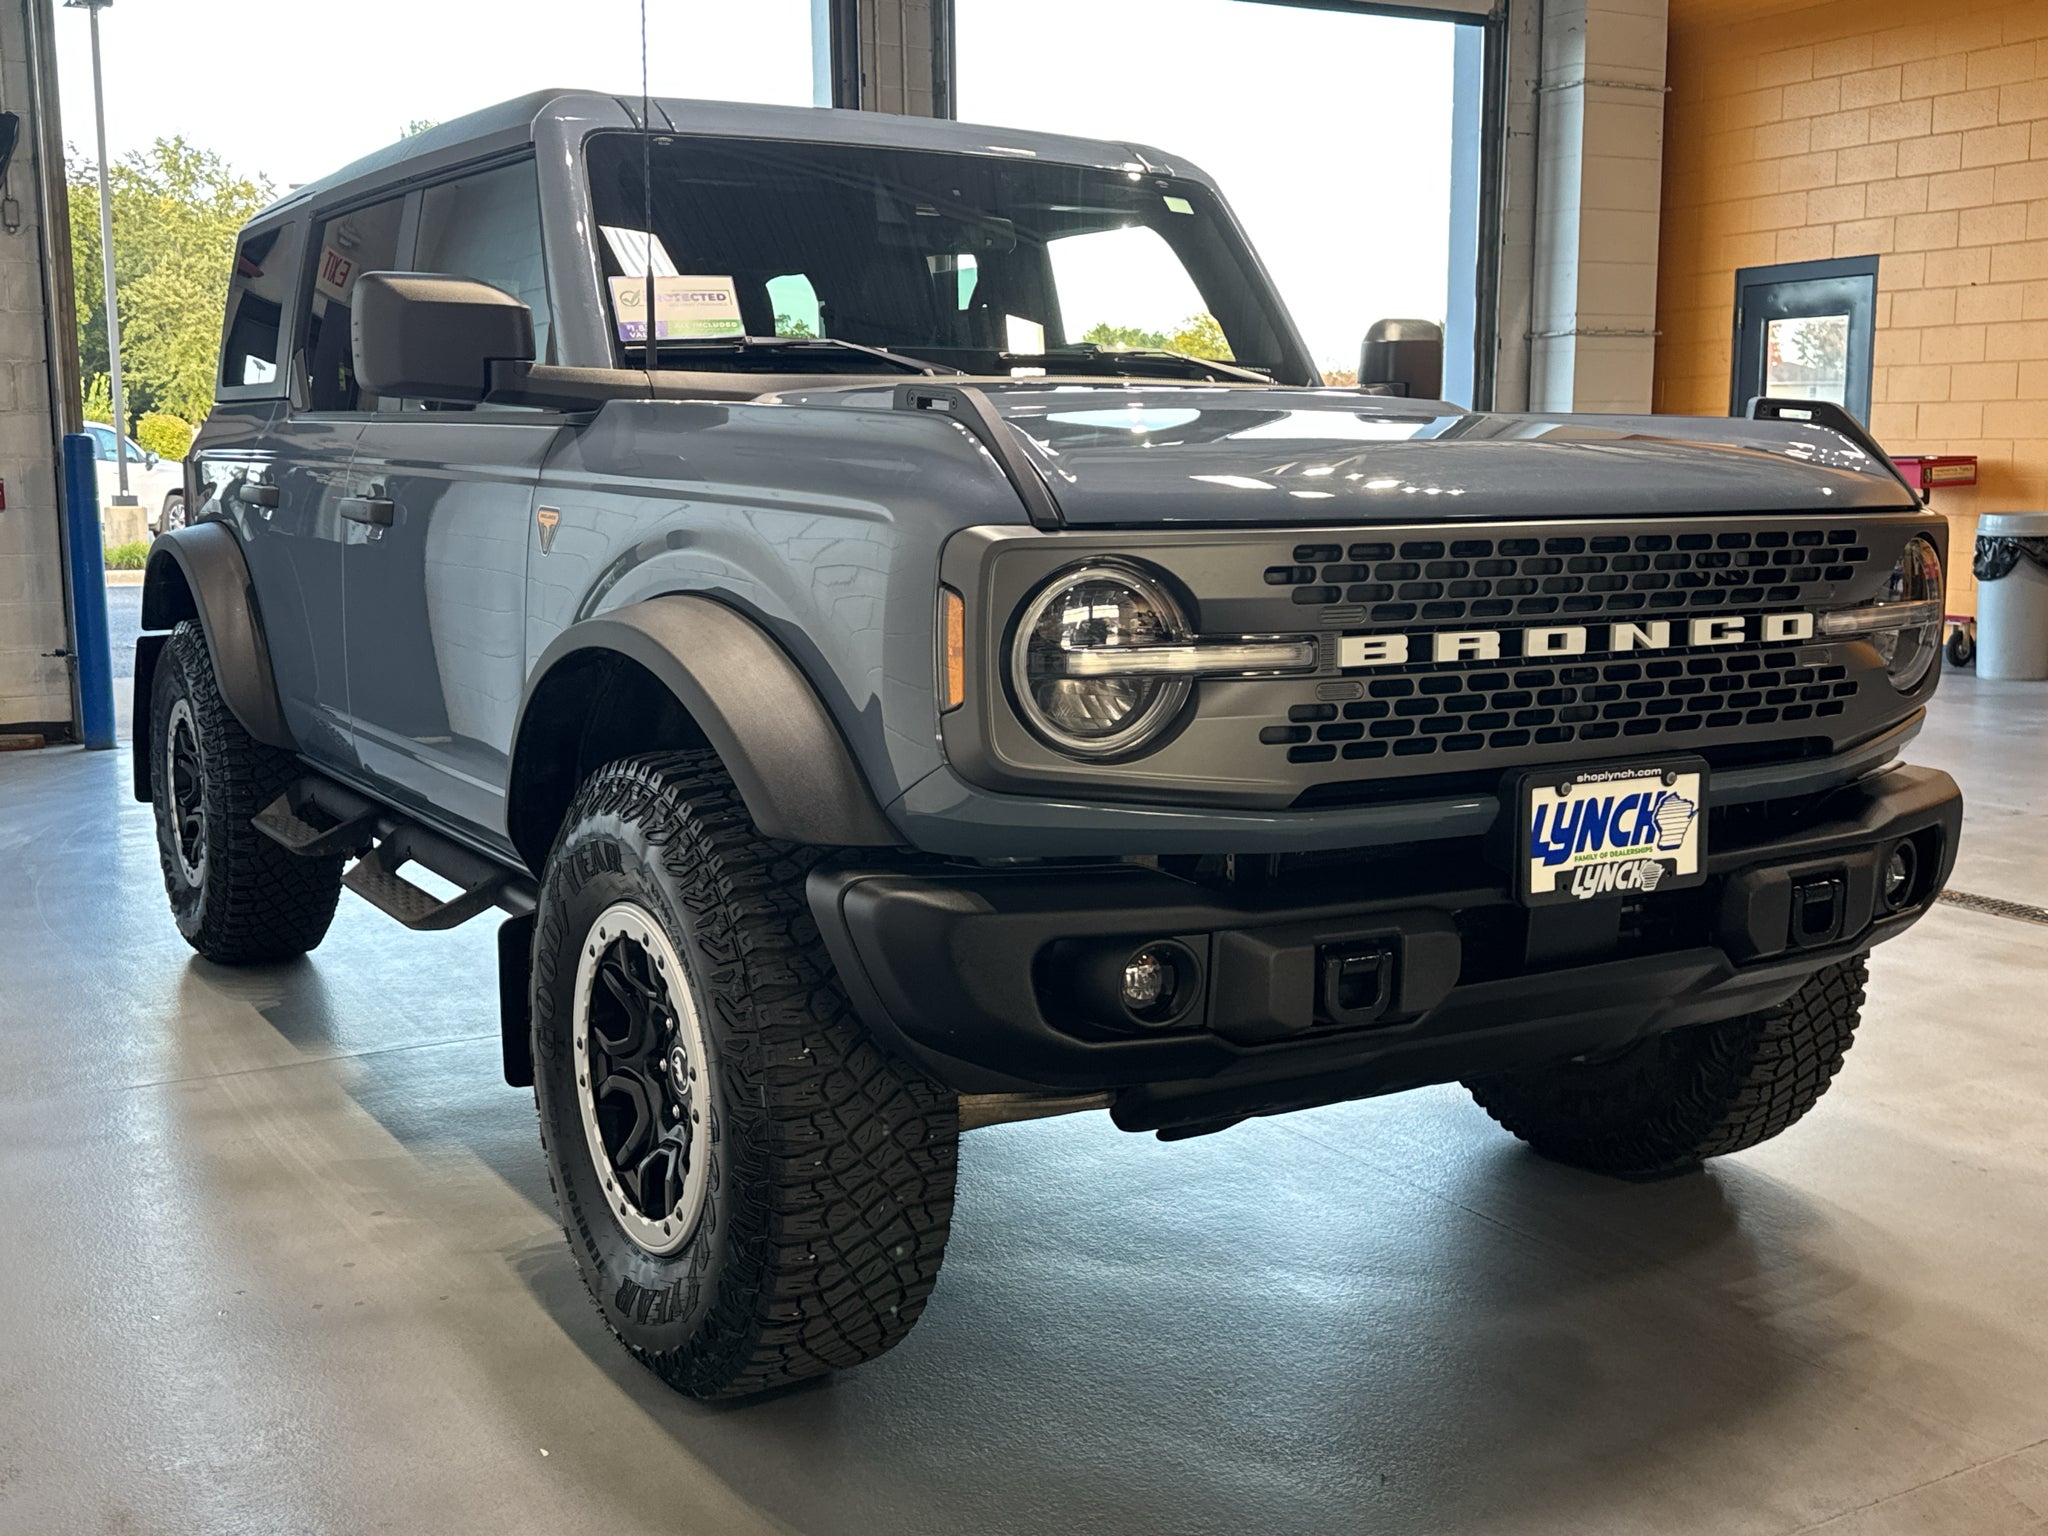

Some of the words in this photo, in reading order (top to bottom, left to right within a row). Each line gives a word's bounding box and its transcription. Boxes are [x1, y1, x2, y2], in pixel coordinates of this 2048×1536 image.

[1337, 612, 1814, 668] BRONCO
[1576, 767, 1662, 783] shoplynch.com
[1531, 790, 1667, 867] LYNCH
[1574, 853, 1598, 862] FAMILY
[1599, 851, 1609, 859] OF
[1610, 846, 1653, 858] DEALERSHIPS
[1571, 859, 1649, 900] LYNCH
